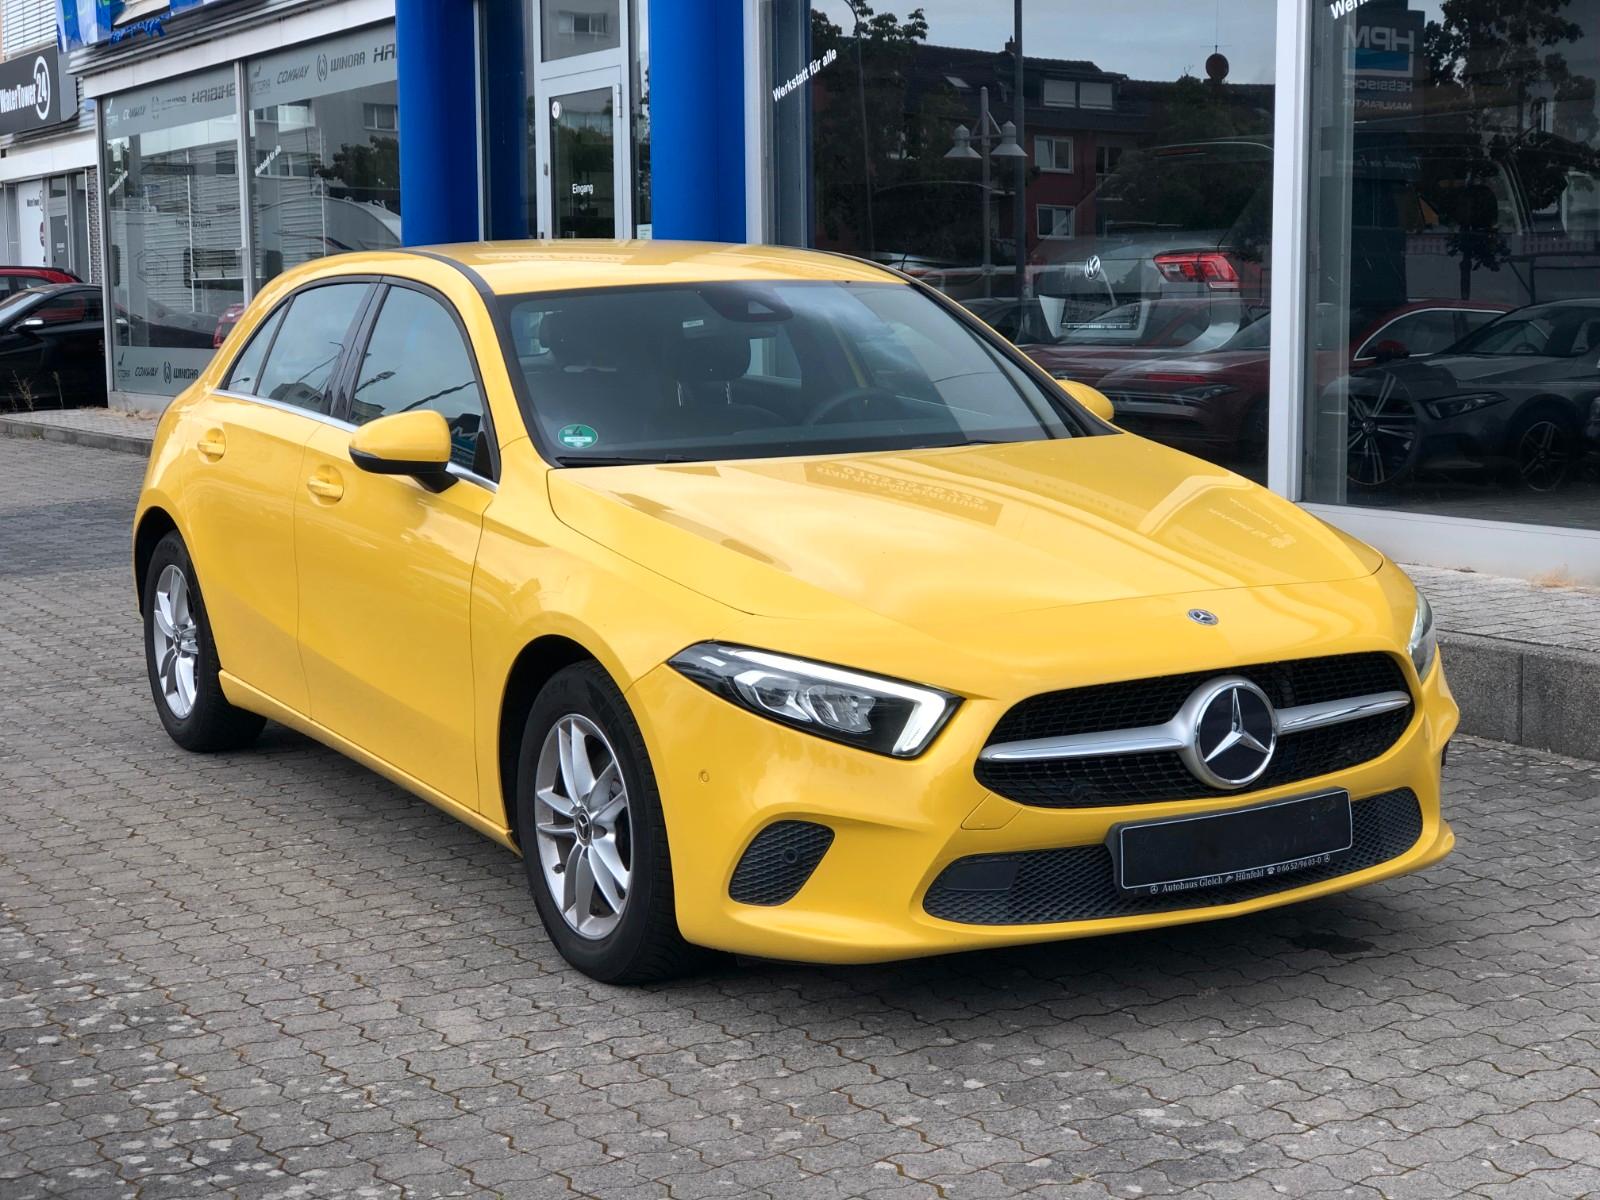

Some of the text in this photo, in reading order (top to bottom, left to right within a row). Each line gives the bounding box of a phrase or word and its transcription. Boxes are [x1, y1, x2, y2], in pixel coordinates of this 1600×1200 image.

[277, 65, 310, 85] CONWAY
[772, 48, 837, 102] Werkstatt für alle
[572, 183, 594, 195] Eingang
[1162, 878, 1198, 893] Autohaus
[1199, 874, 1223, 888] Gleich
[1235, 869, 1264, 882] Hünfeld
